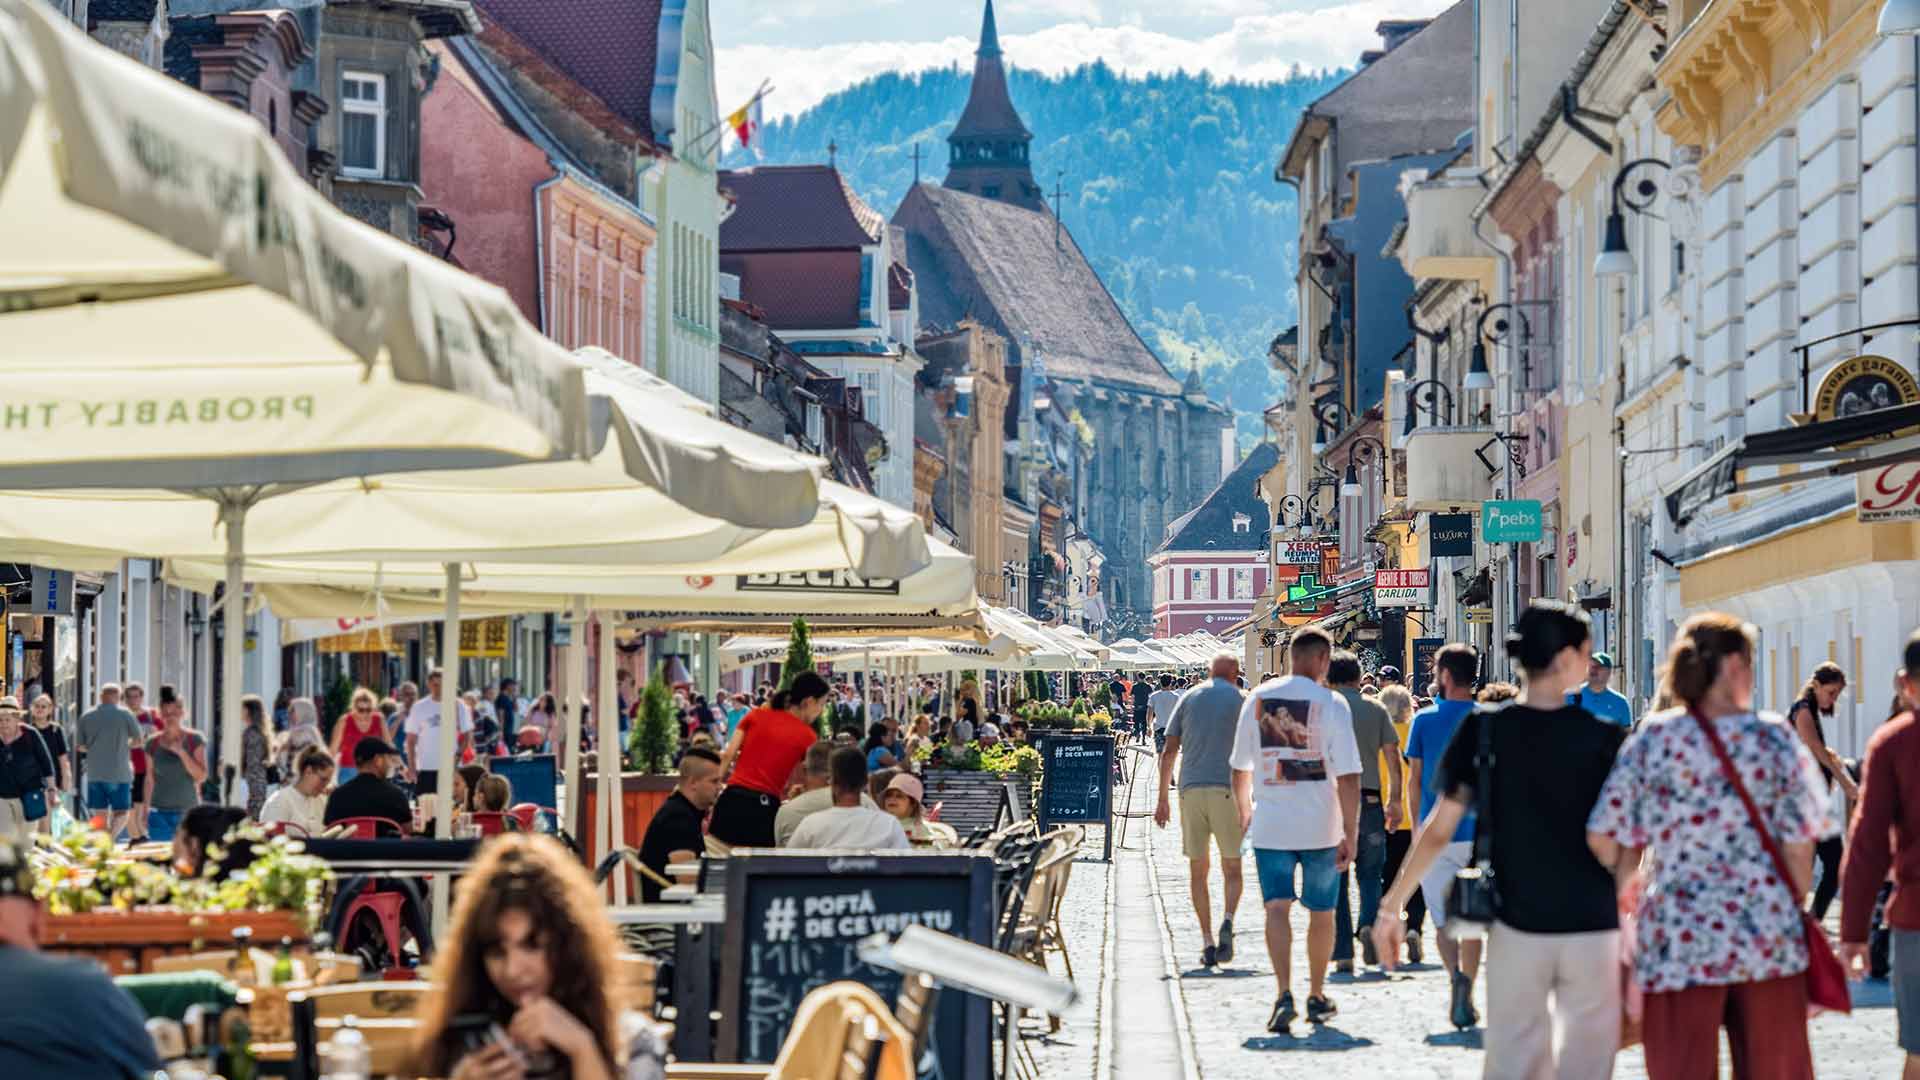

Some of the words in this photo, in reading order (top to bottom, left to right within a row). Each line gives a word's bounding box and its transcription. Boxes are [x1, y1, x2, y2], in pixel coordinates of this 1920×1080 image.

[1500, 511, 1536, 529] pebs
[1433, 530, 1469, 541] LUXURY
[1377, 588, 1417, 599] CARLIDA
[805, 917, 834, 939] DE
[837, 915, 869, 937] CE
[921, 909, 953, 931] TU
